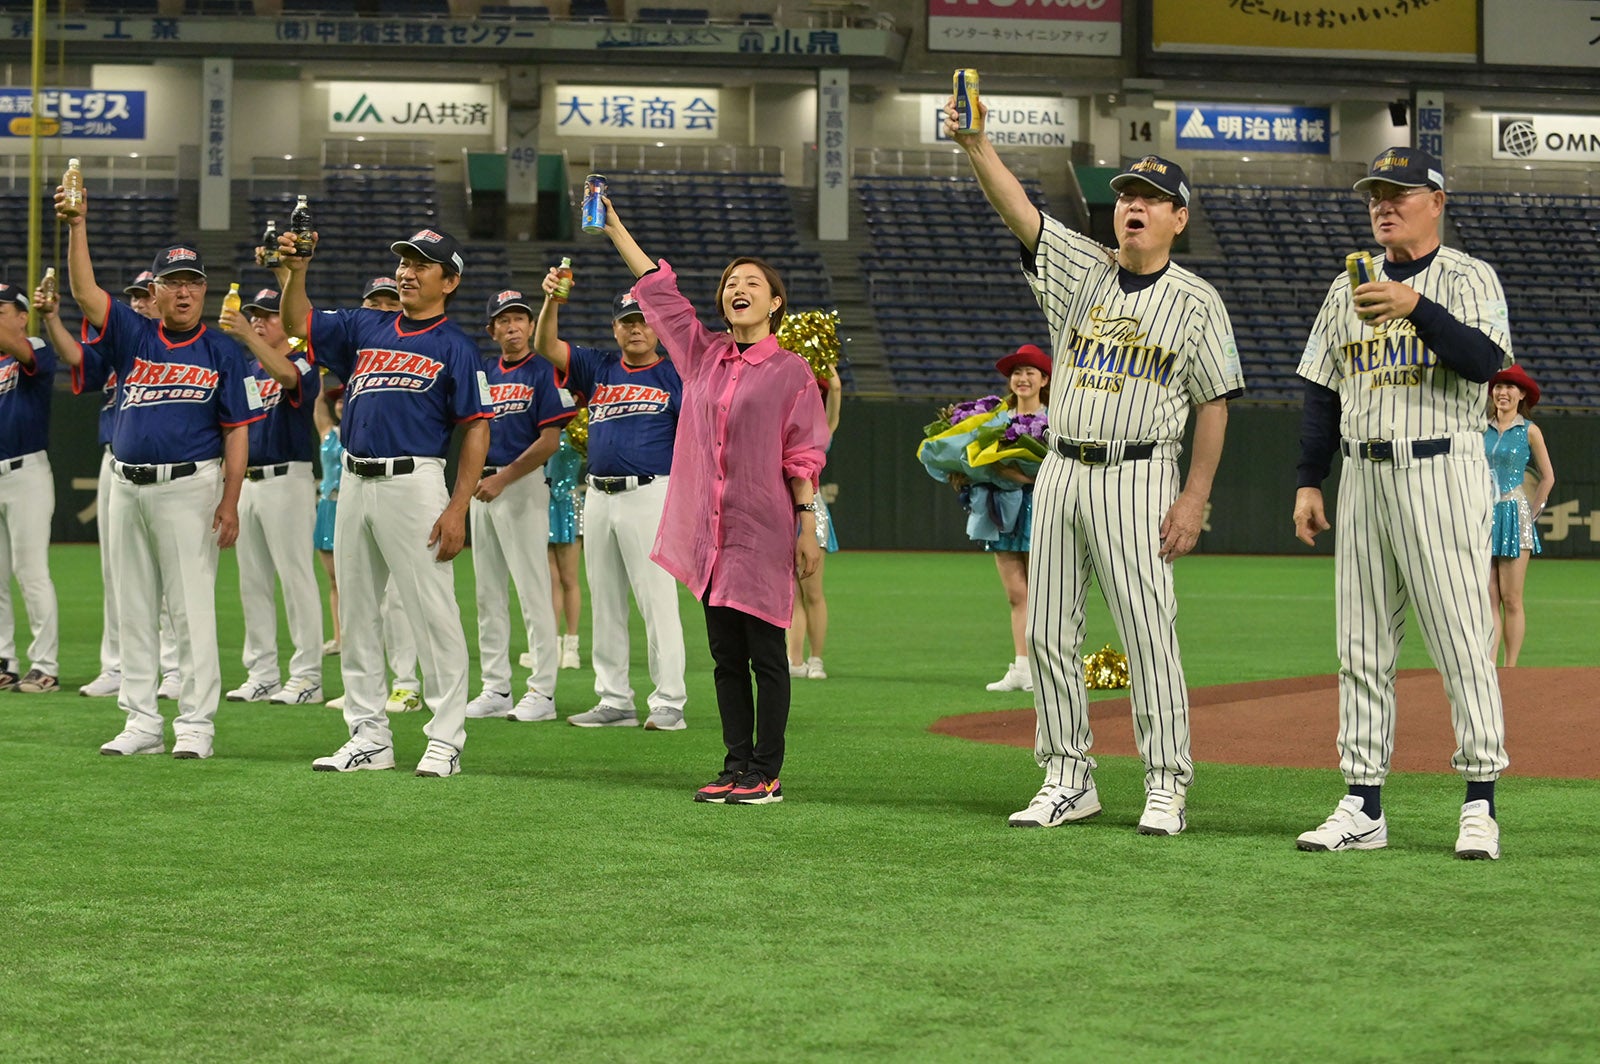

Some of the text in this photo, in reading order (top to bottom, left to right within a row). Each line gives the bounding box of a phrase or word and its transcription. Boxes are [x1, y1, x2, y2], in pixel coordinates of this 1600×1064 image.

[391, 102, 488, 125] JA共済
[557, 96, 717, 130] 大塚商会
[1128, 121, 1152, 142] 14
[1217, 115, 1325, 142] 明治機械
[125, 358, 219, 388] DREAM
[354, 350, 443, 379] DREAM
[127, 386, 206, 404] Heroes
[352, 374, 424, 396] Heroes
[489, 384, 535, 403] REAM
[589, 383, 670, 405] DREAM
[593, 403, 658, 420] Heroes
